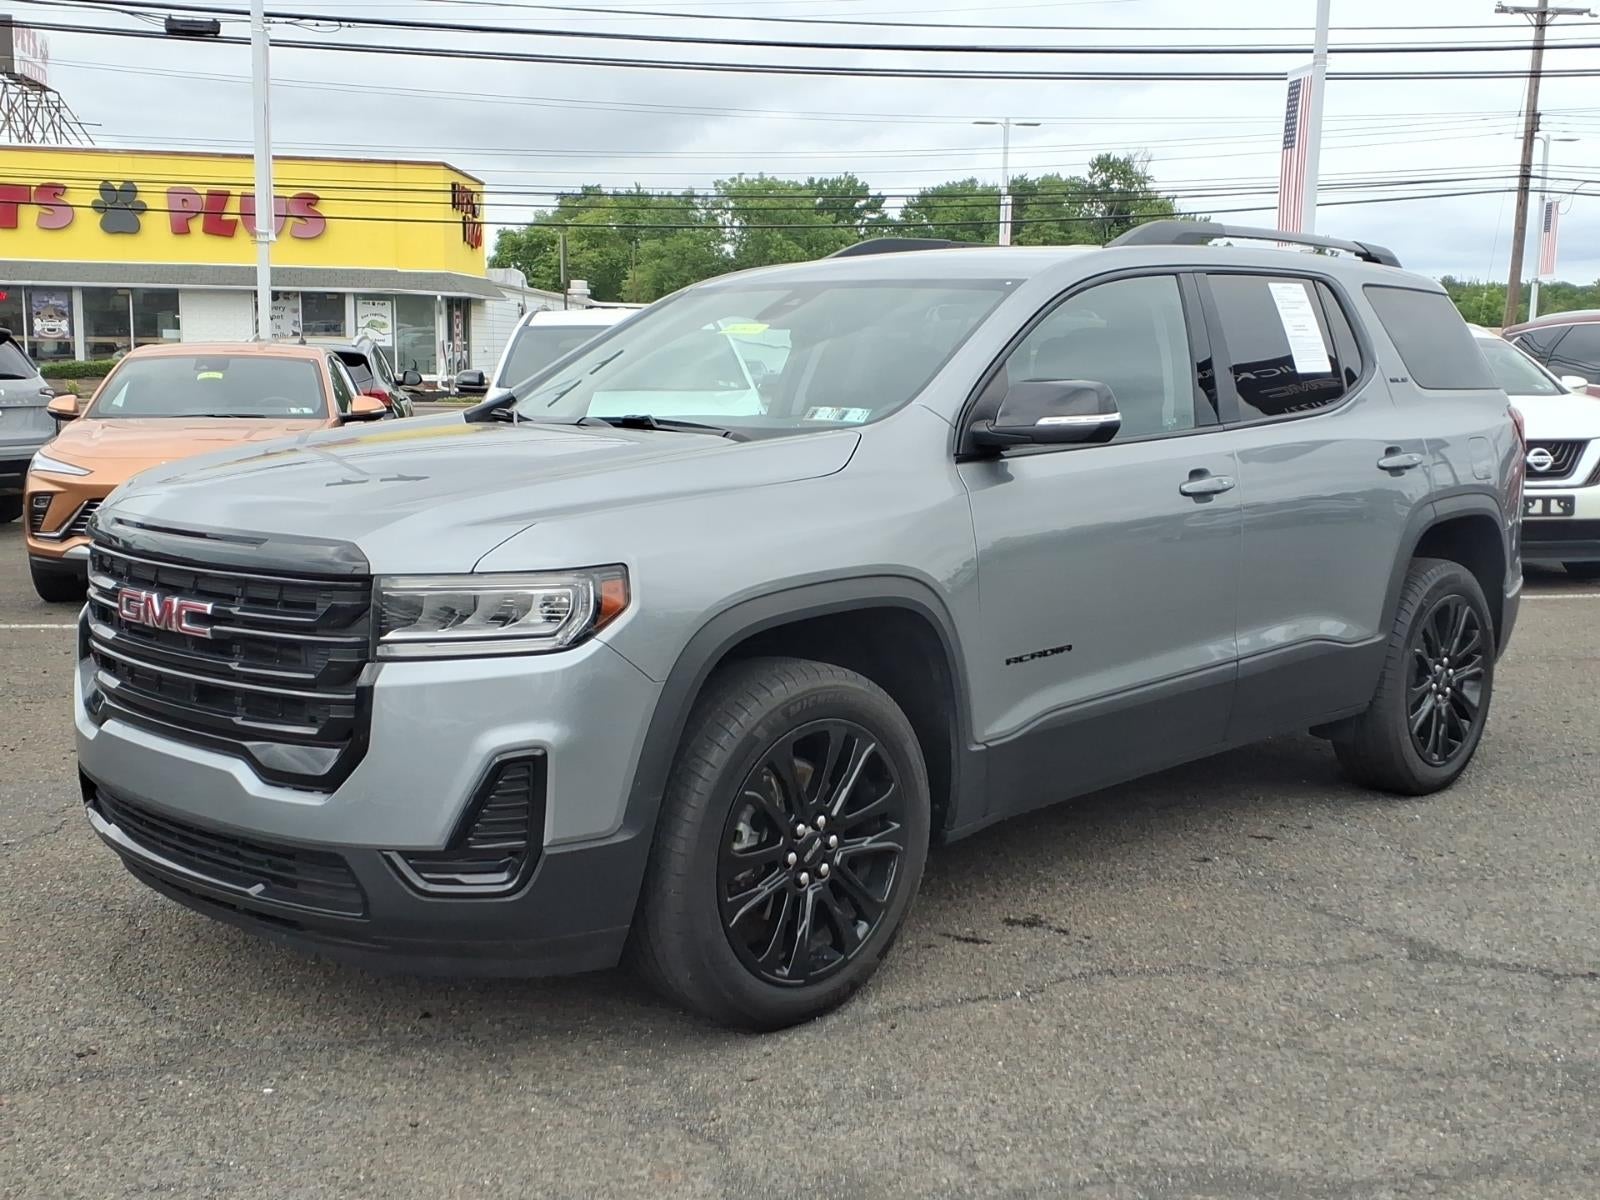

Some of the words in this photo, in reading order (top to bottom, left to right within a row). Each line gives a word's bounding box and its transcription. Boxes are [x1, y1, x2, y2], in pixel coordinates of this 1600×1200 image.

[166, 186, 326, 239] PLUS
[118, 587, 213, 639] GMC
[1005, 644, 1072, 666] ACADIA
